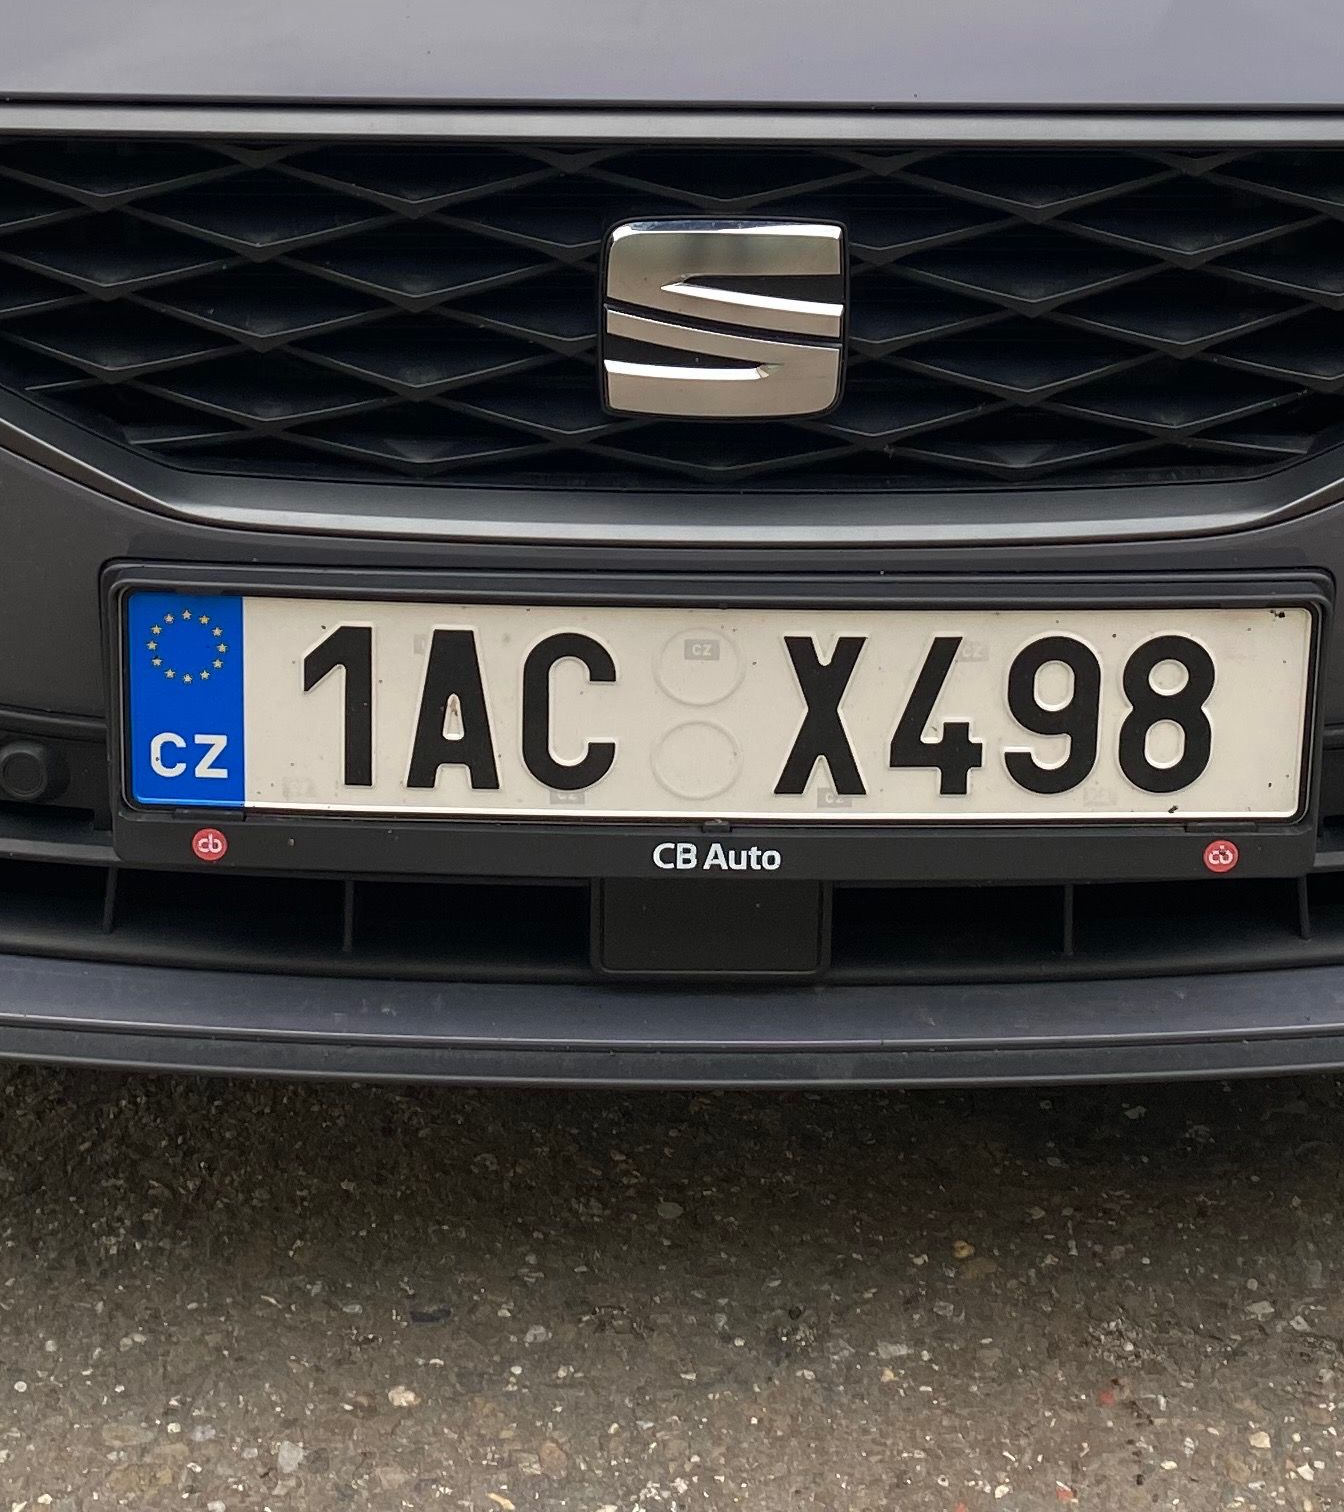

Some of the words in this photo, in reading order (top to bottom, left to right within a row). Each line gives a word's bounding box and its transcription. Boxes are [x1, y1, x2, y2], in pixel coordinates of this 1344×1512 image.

[303, 626, 617, 790] 1AC
[773, 634, 1216, 795] X498
[151, 732, 228, 779] CZ
[652, 842, 697, 869] CB
[702, 842, 781, 870] Auto
